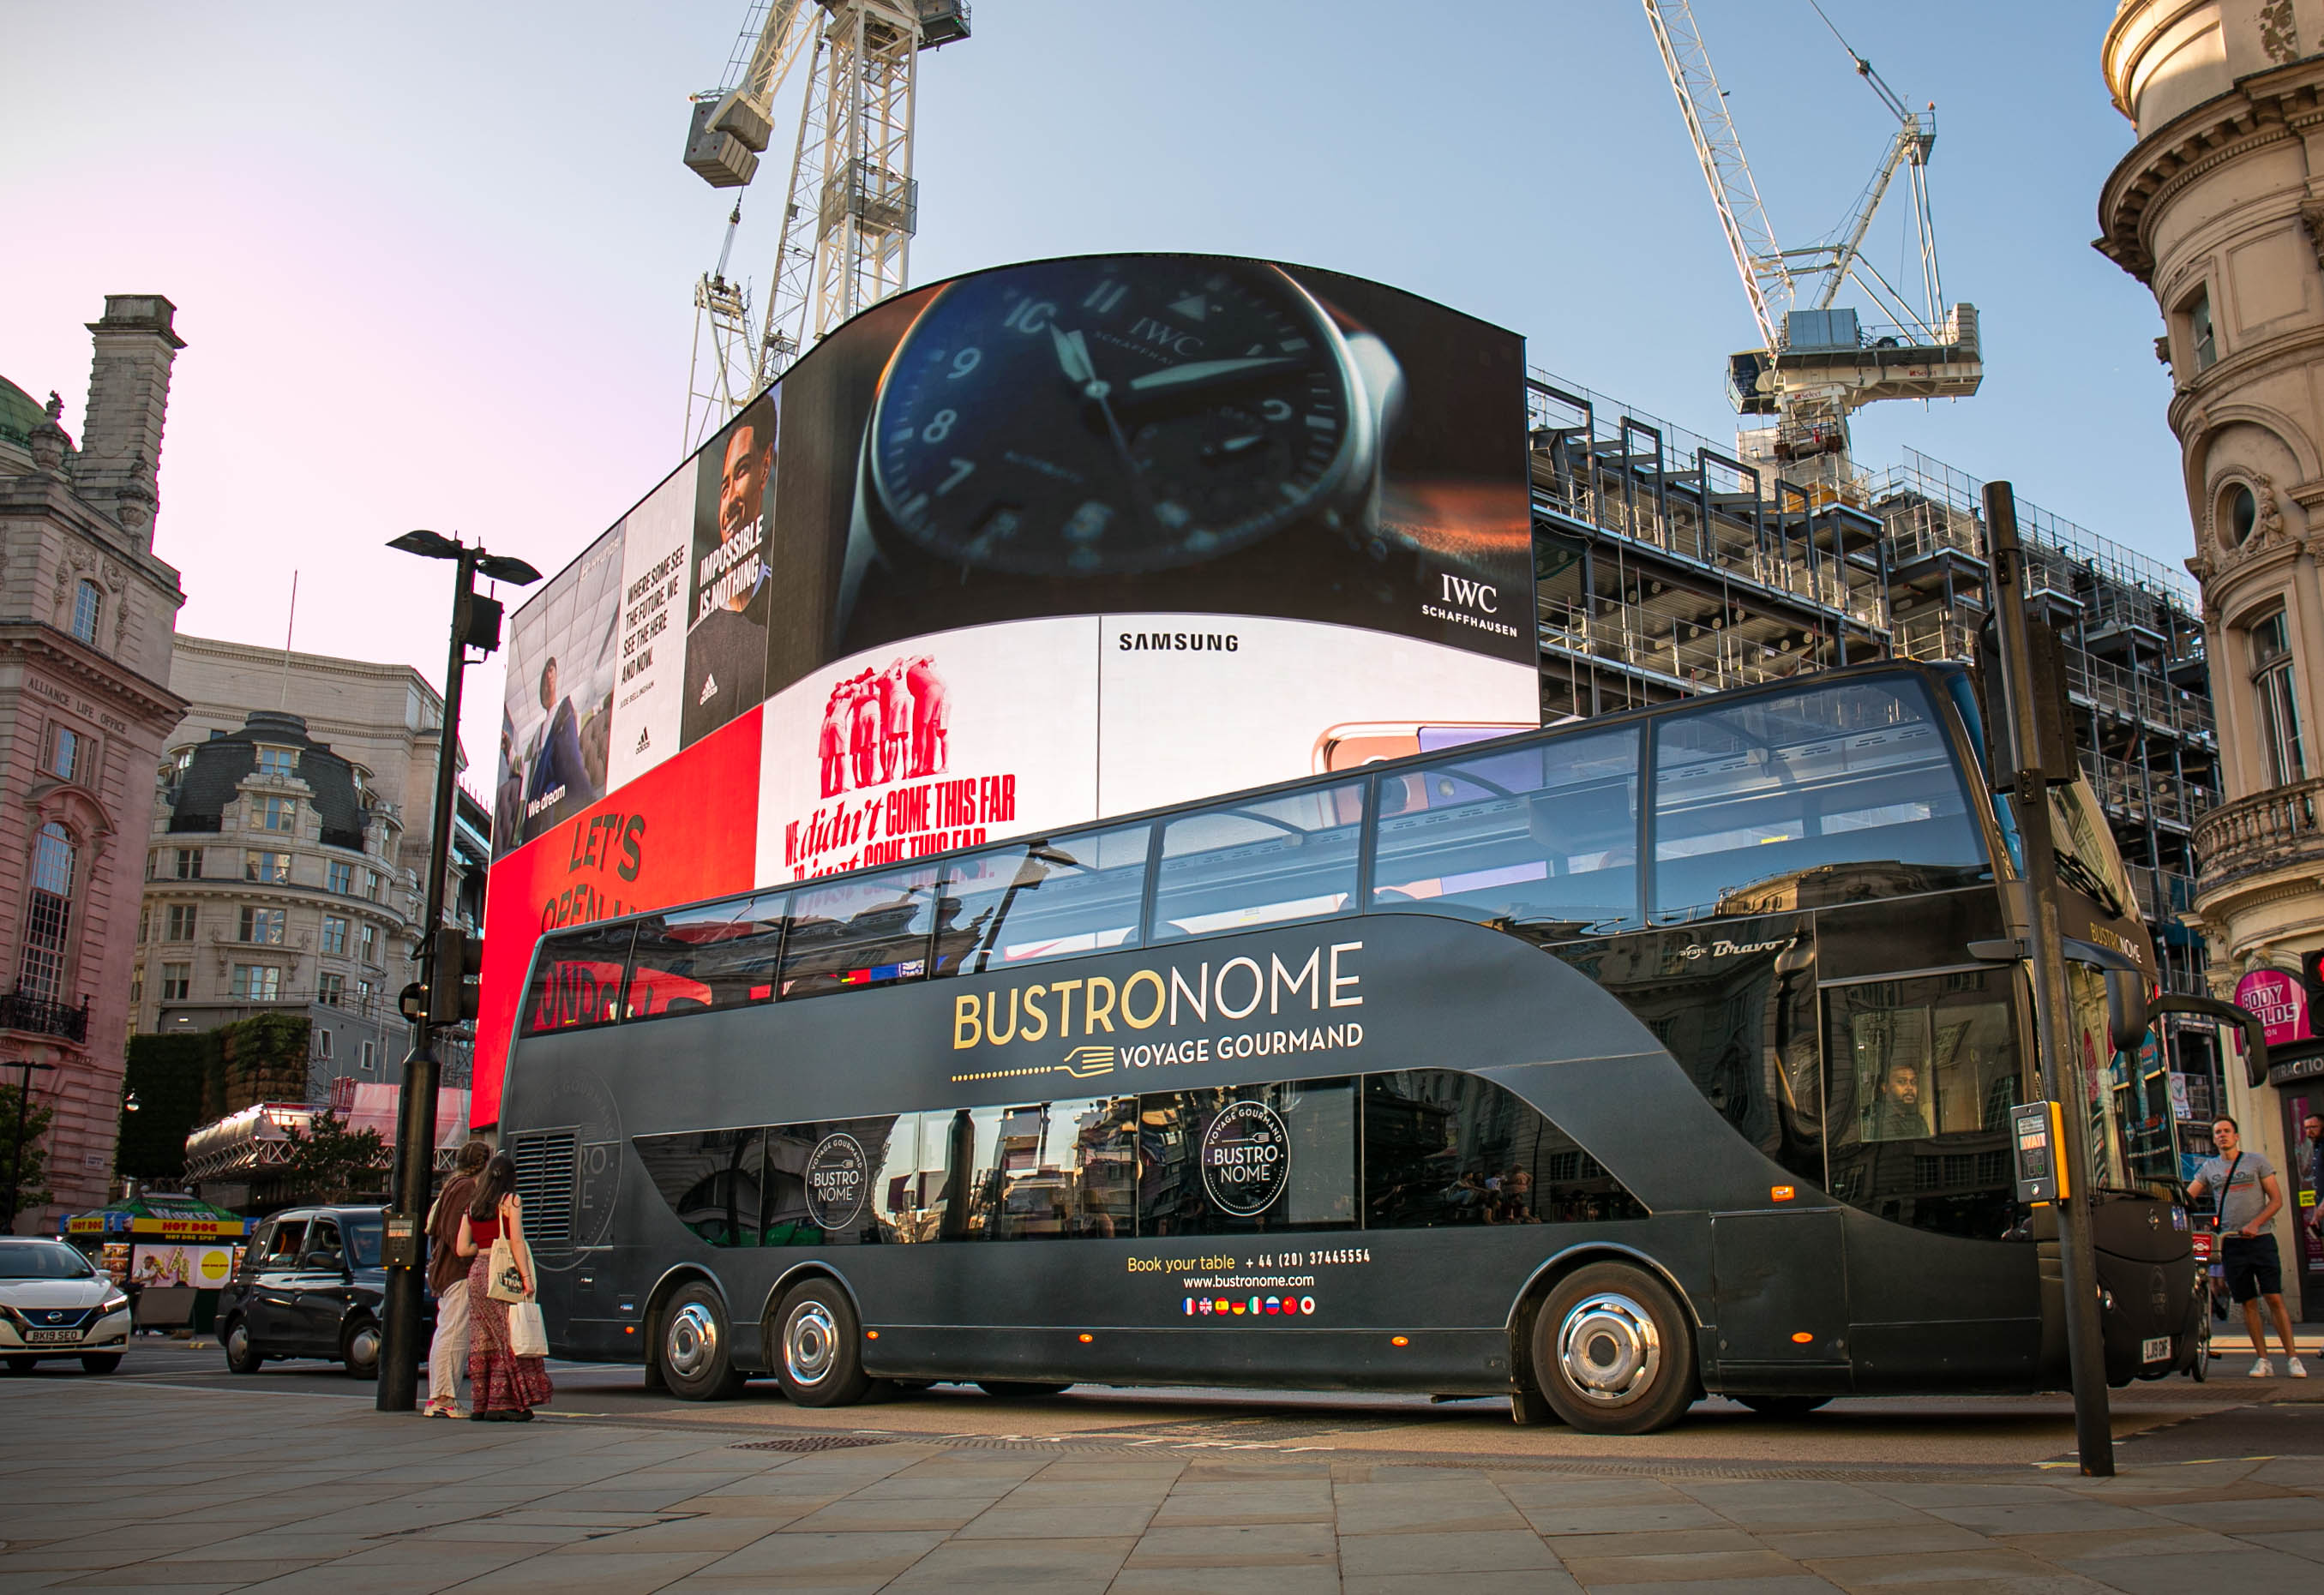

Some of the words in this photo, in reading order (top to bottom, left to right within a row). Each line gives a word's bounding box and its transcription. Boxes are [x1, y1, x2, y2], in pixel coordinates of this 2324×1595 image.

[1130, 317, 1204, 357] IWC
[946, 347, 982, 379] 9
[922, 409, 958, 444] 8
[936, 459, 976, 496] 7
[699, 514, 764, 588] IMPOSSIBLE
[628, 571, 651, 607] WHERE
[651, 555, 671, 588] SOME
[671, 544, 685, 573] SEE
[699, 589, 711, 621] IS
[712, 553, 760, 610] NOTHING
[626, 606, 639, 632] THE
[667, 574, 679, 601] WE
[1441, 573, 1498, 614] IWC
[623, 633, 636, 659] SEE
[636, 621, 650, 647] THE
[650, 609, 668, 639] HERE
[1421, 603, 1517, 638] SCHAFFHAUSEN
[1118, 633, 1239, 652] SAMSUNG
[621, 659, 636, 687] AND
[636, 645, 653, 675] NOW.
[28, 678, 70, 706] ALLIANCE
[76, 700, 95, 718] LIFE
[100, 713, 126, 735] OFFICE
[629, 680, 654, 704] BELLINGHAM
[527, 801, 540, 818] We
[541, 784, 566, 811] dream
[785, 819, 800, 867] WE
[801, 795, 884, 858] didn't
[886, 784, 931, 837] COME
[935, 777, 976, 829] THIS
[980, 774, 1016, 824] FAR
[568, 813, 646, 882] LET'S
[542, 884, 604, 933] OPEN
[1712, 939, 1785, 956] Bravo
[2089, 921, 2142, 964] BUSTRONOME
[952, 940, 1363, 1051] BUSTRONOME
[2241, 984, 2283, 1010] BODY
[2254, 1001, 2300, 1027] RLDS
[1120, 1038, 1210, 1069] VOYAGE
[1216, 1022, 1363, 1060] GOURMAND
[1208, 1112, 1237, 1145] VOYAGE
[1238, 1108, 1282, 1142] GOURMAND
[2021, 1134, 2044, 1148] WAIT
[811, 1142, 832, 1170] VOYAGE
[832, 1139, 862, 1169] GOURMAND
[1214, 1145, 1278, 1166] BUSTRO
[814, 1170, 859, 1187] BUSTRO
[1221, 1164, 1270, 1184] NOME
[818, 1186, 853, 1202] NOME
[71, 1220, 86, 1230] HOT
[87, 1219, 103, 1229] DOG
[162, 1222, 188, 1232] HOT
[191, 1222, 218, 1232] DOG
[1127, 1256, 1162, 1272] Book
[1165, 1257, 1196, 1274] your
[1199, 1254, 1235, 1270] table
[1258, 1254, 1272, 1268] 44
[1278, 1251, 1303, 1268] (20)
[1309, 1248, 1371, 1266] 37445554
[1183, 1274, 1314, 1288] www.bustronome.com
[33, 1331, 56, 1340] BK19
